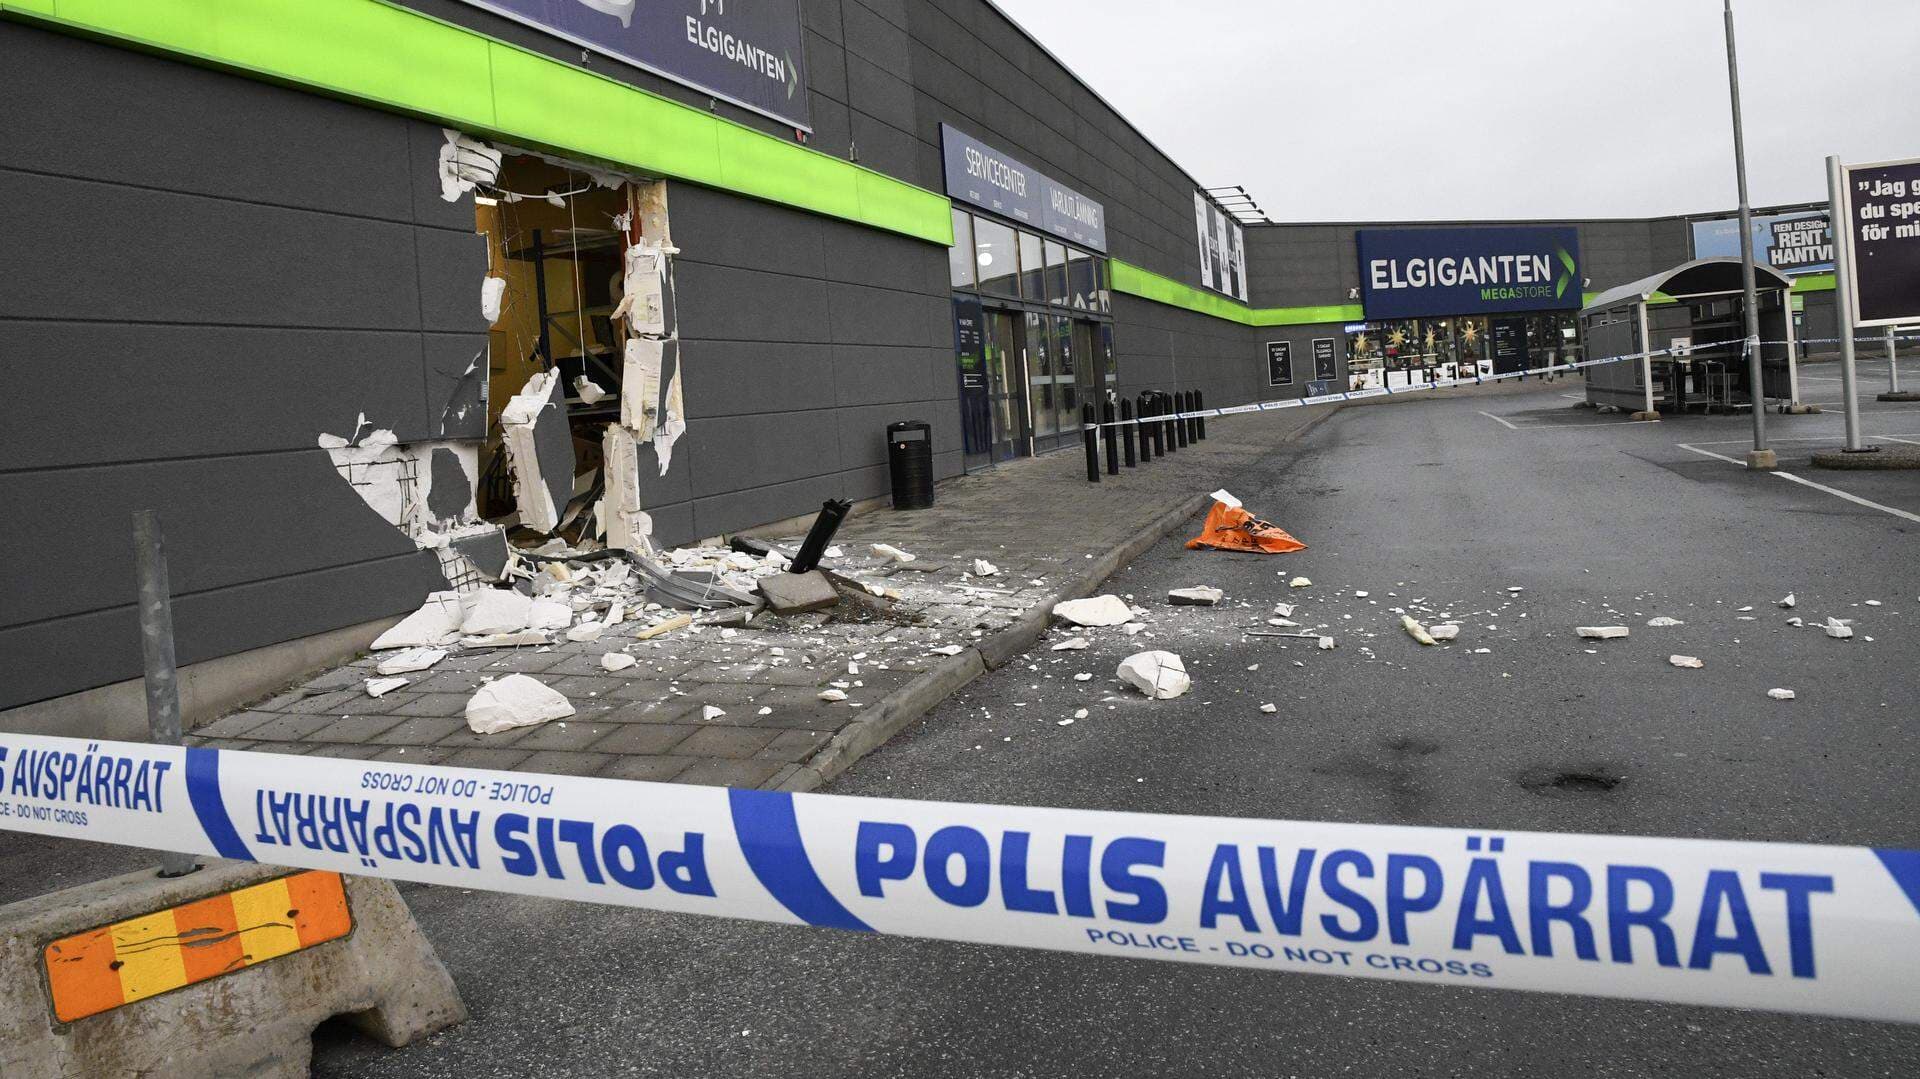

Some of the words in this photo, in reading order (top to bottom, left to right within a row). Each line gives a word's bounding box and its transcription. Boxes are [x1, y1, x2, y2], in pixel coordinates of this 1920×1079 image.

[686, 15, 786, 83] ELGIGANTEN
[965, 146, 1027, 198] SERVICECENTER
[1050, 186, 1098, 229] VARUUTLÄMNING
[1860, 203, 1885, 219] du
[1773, 223, 1792, 233] REN
[1779, 229, 1823, 248] RENT
[1861, 223, 1890, 241] för
[1895, 220, 1920, 238] mi
[1370, 254, 1551, 290] ELGIGANTEN
[1480, 286, 1552, 301] MEGASTORE
[11, 744, 172, 813] AVSPÄRRAT
[361, 771, 413, 792] CROSS
[415, 775, 449, 796] NOT
[452, 779, 477, 798] DO
[489, 782, 554, 805] POLICE
[17, 804, 31, 818] DO
[33, 806, 51, 821] NOT
[54, 808, 88, 826] CROSS
[255, 788, 480, 870] AVSPÄRRAT
[495, 811, 717, 897] POLIS
[855, 821, 1169, 925] POLIS
[1200, 836, 1834, 980] AVSPÄRRAT
[1086, 928, 1200, 953] POLICE
[1225, 941, 1275, 960] DO
[1287, 947, 1353, 966] NOT
[1365, 953, 1494, 978] CROSS
